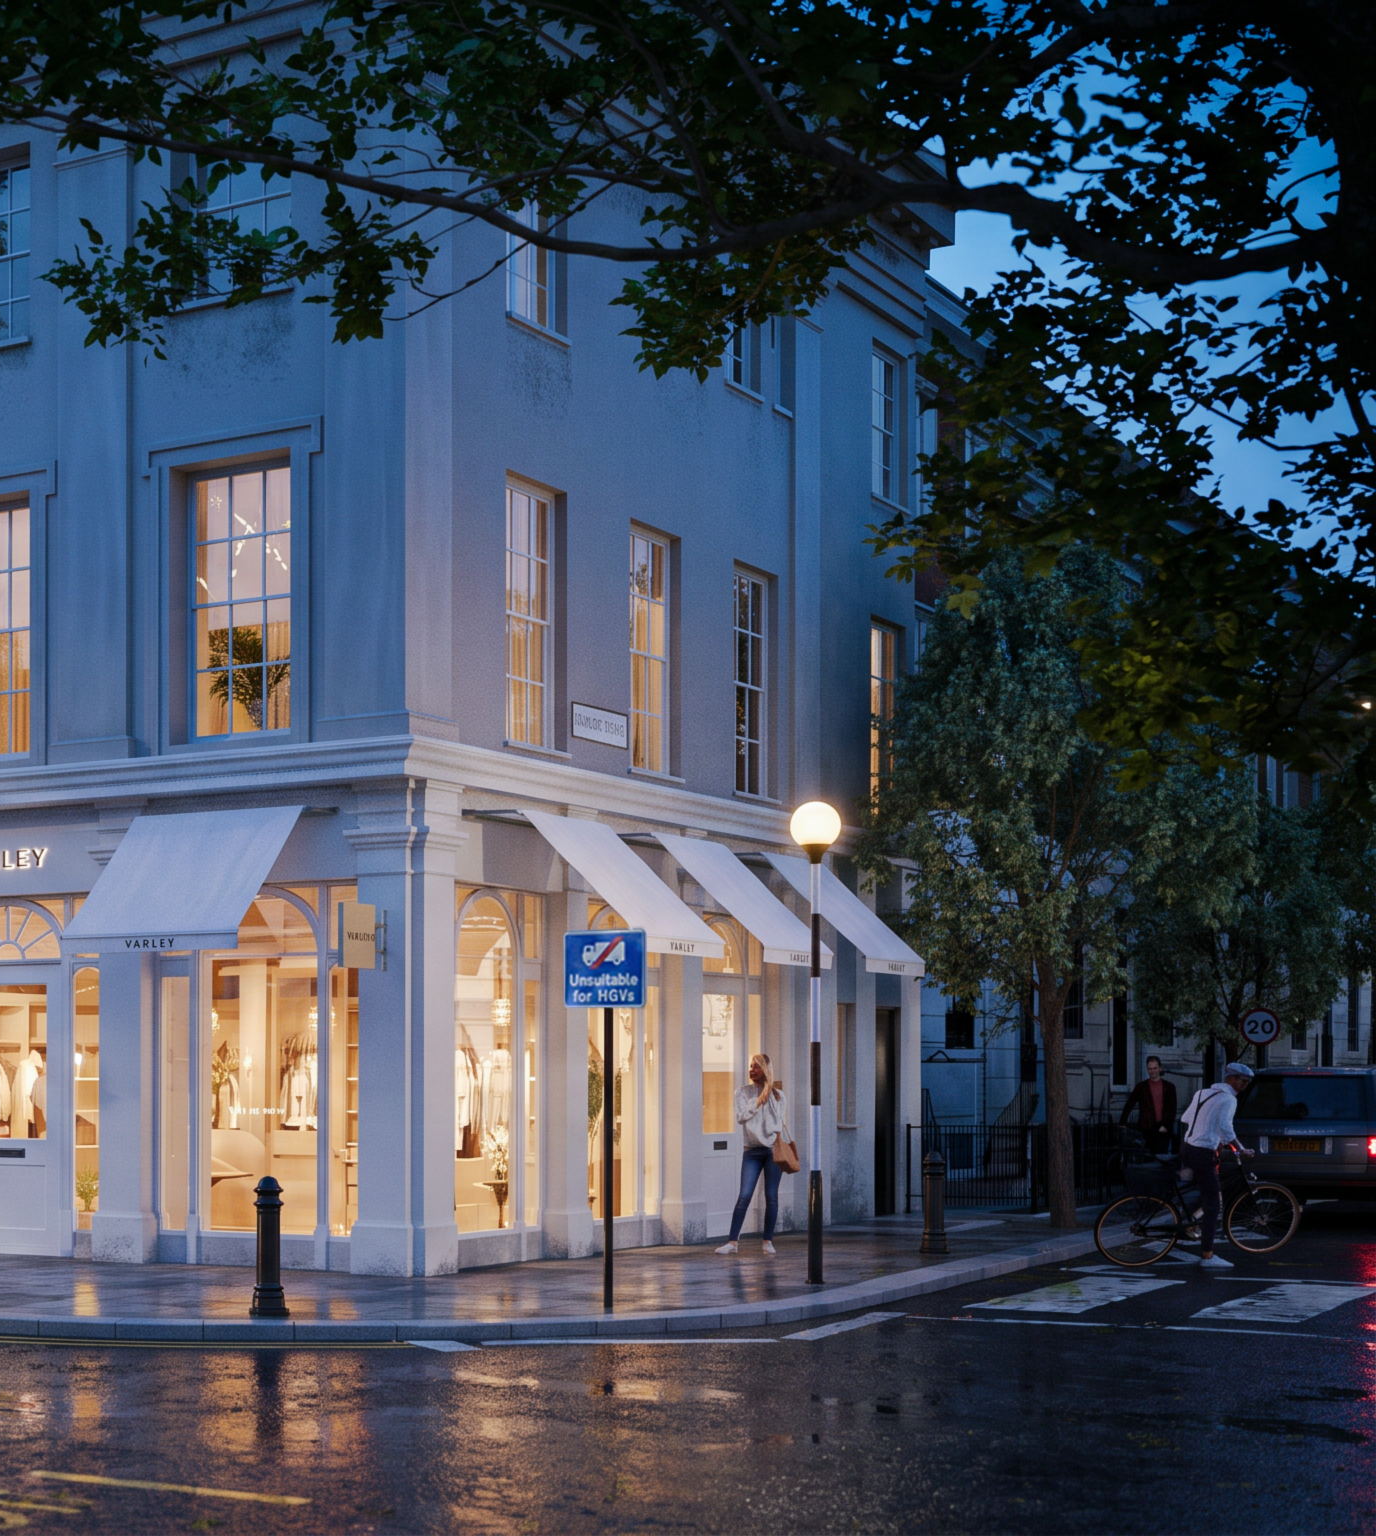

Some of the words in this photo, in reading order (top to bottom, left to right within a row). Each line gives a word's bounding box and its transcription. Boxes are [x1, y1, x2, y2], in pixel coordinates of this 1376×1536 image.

[125, 938, 175, 949] VARLEY
[569, 973, 638, 987] Unsuitable
[573, 989, 593, 1002] for
[598, 989, 635, 1002] HGVs
[1247, 1019, 1274, 1035] 20
